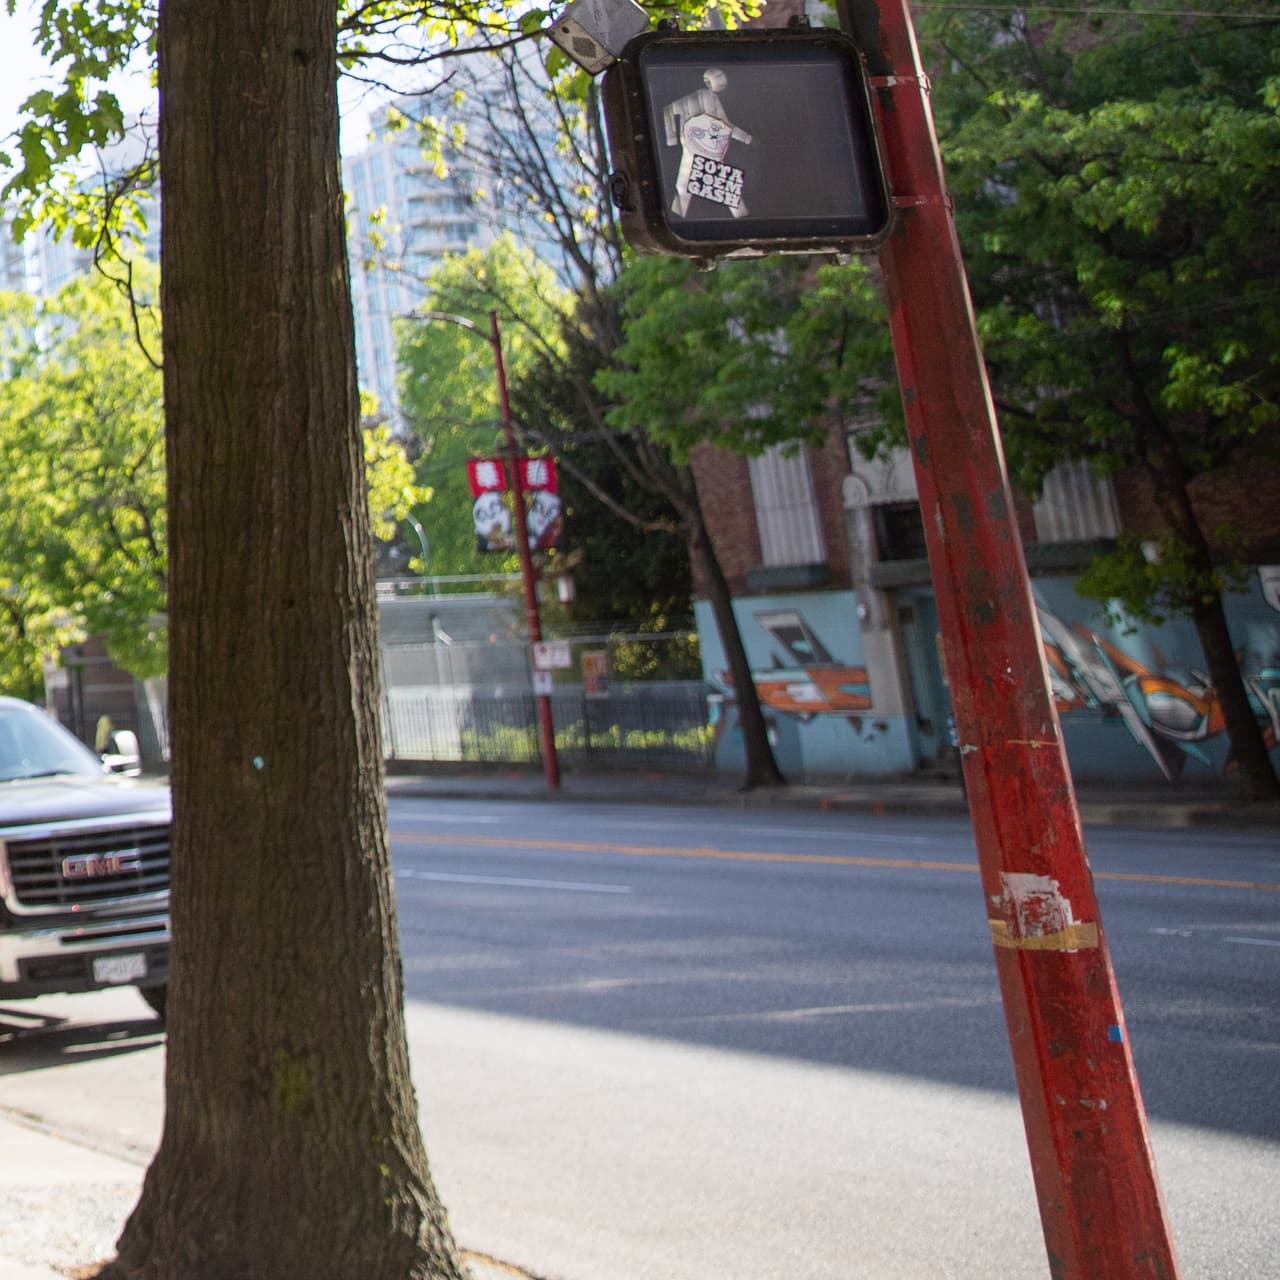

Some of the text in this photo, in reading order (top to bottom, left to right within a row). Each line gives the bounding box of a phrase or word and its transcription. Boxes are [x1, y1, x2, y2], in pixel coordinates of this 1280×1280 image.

[689, 168, 744, 195] POEM
[692, 156, 744, 184] SOTA
[62, 848, 141, 879] GMC
